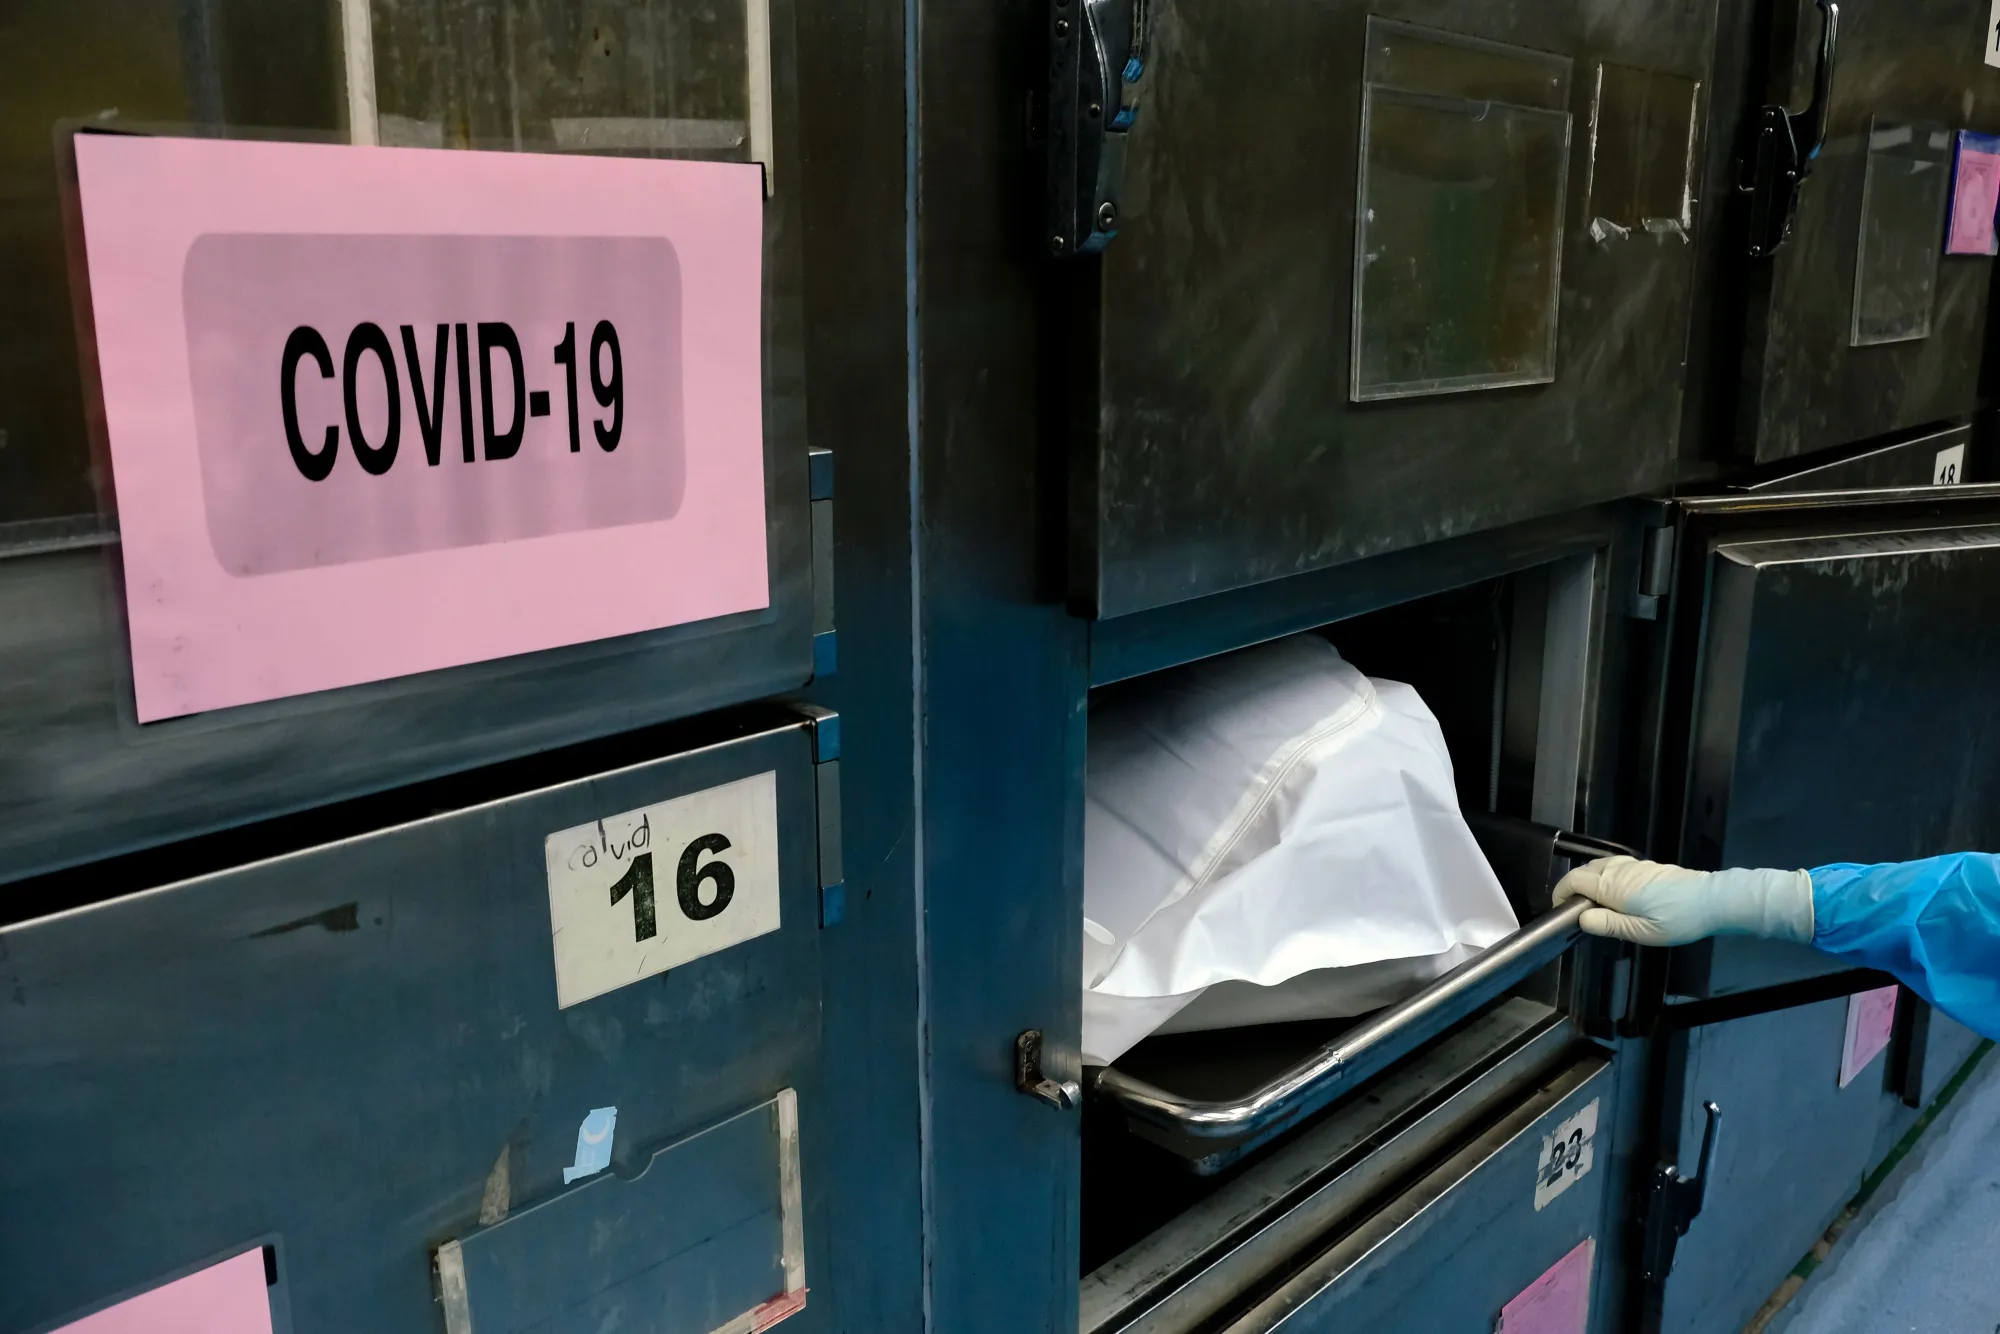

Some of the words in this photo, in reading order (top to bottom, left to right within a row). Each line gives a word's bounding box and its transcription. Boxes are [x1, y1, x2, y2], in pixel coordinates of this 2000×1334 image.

[280, 319, 624, 482] COVID-19
[610, 832, 736, 943] 16
[1545, 1127, 1583, 1188] 23
